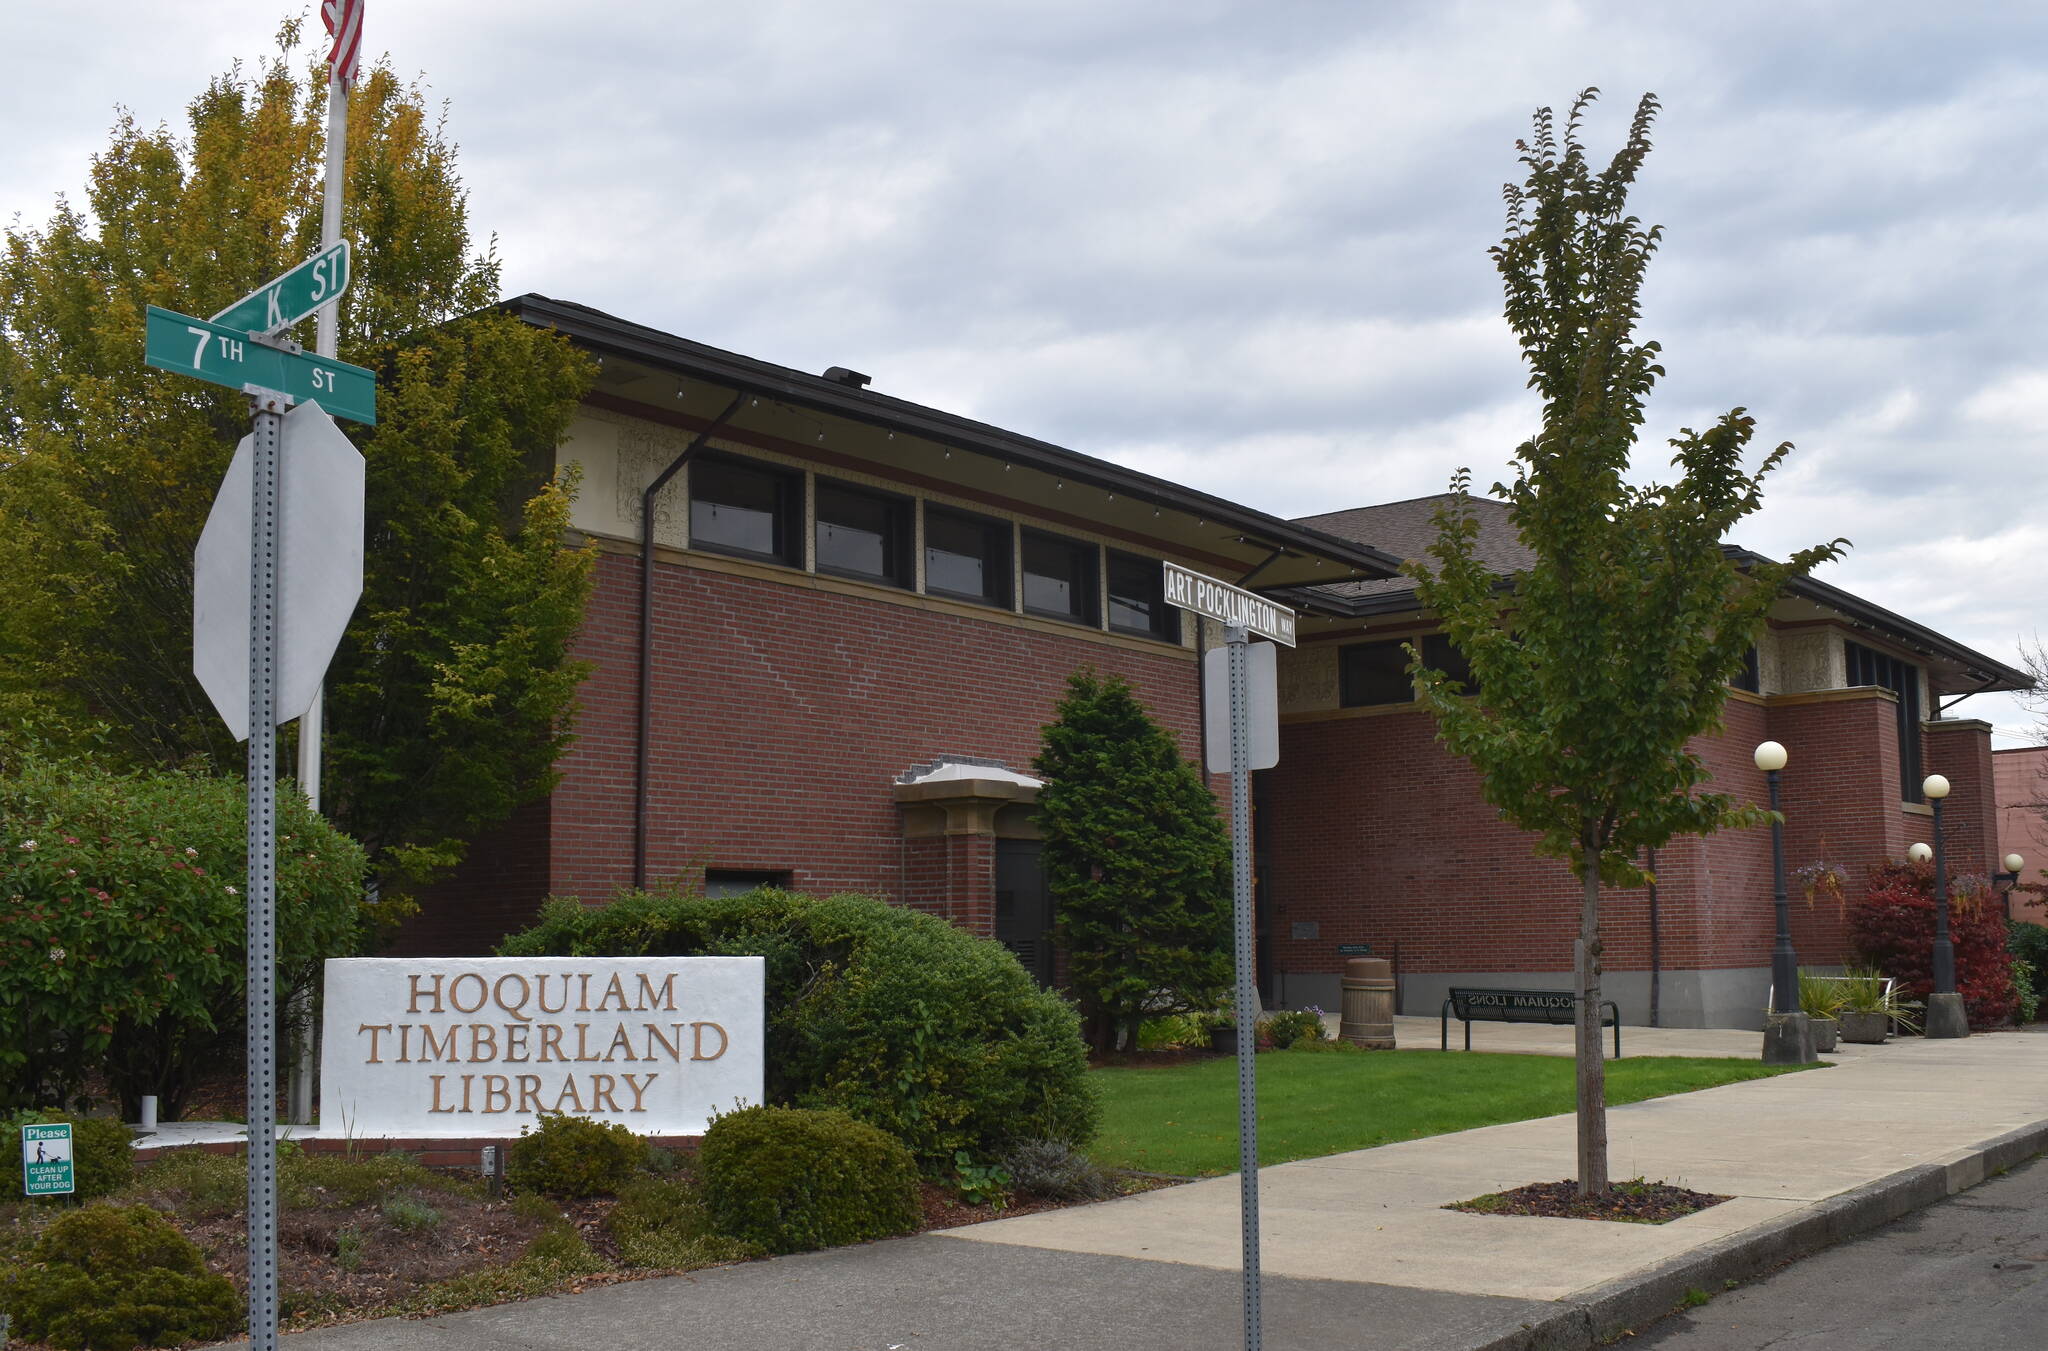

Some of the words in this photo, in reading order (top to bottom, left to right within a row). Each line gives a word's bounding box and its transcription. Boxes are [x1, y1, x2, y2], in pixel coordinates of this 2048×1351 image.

[267, 284, 283, 328] K
[311, 247, 342, 302] ST
[188, 326, 243, 370] 7TH
[312, 367, 335, 393] ST
[1168, 569, 1193, 605] ART
[1197, 579, 1277, 636] POCKLINGTON
[1280, 617, 1293, 635] WAY
[406, 971, 679, 1022] HOQUIAM
[358, 1021, 729, 1064] TIMBERLAND
[428, 1072, 659, 1114] LIBRARY
[27, 1129, 68, 1139] Please
[30, 1166, 56, 1175] CLEAN
[37, 1174, 62, 1182] AFTER
[53, 1181, 71, 1189] DOG
